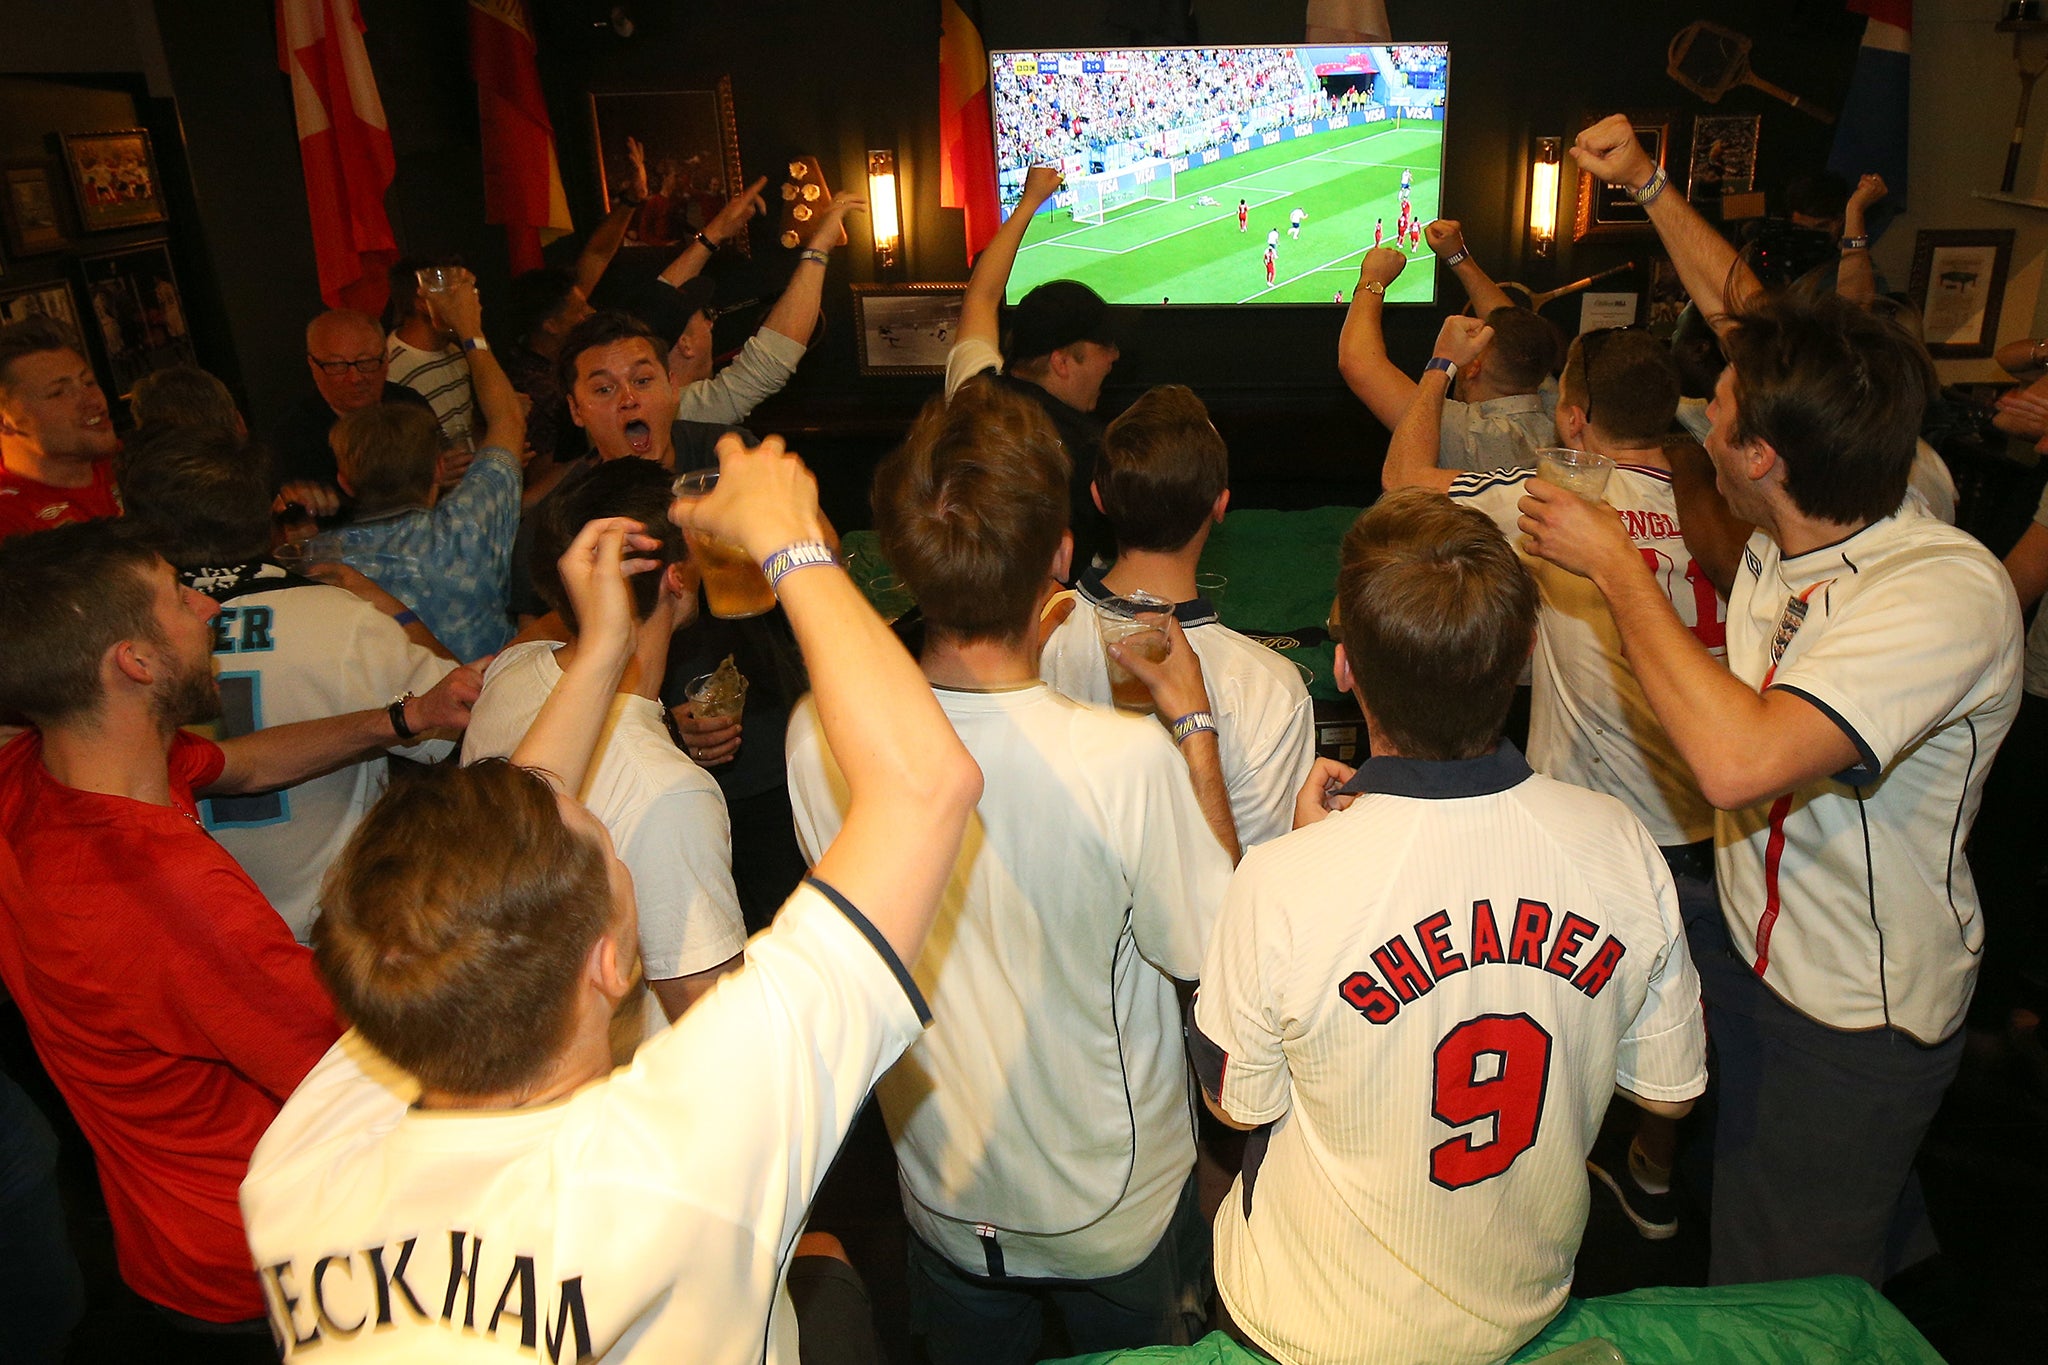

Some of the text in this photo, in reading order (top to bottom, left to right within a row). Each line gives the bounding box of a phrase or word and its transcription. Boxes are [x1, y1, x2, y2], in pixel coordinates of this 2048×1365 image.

[1064, 62, 1078, 70] ENG
[1109, 61, 1124, 69] PAN
[1364, 107, 1386, 123] VISA
[1404, 106, 1433, 120] VISA
[1293, 121, 1313, 138] VISA
[1327, 114, 1349, 131] VISA
[1232, 137, 1250, 155] VISA
[1262, 129, 1280, 147] VISA
[1202, 146, 1220, 165] VISA
[1172, 156, 1189, 174] VISA
[1134, 167, 1156, 185] VISA
[1053, 190, 1080, 209] VISA
[787, 545, 833, 566] HILL
[208, 605, 275, 654] ER
[1338, 898, 1627, 1025] SHEARER
[1429, 1012, 1553, 1192] 9
[261, 1229, 598, 1365] ECKHAM
